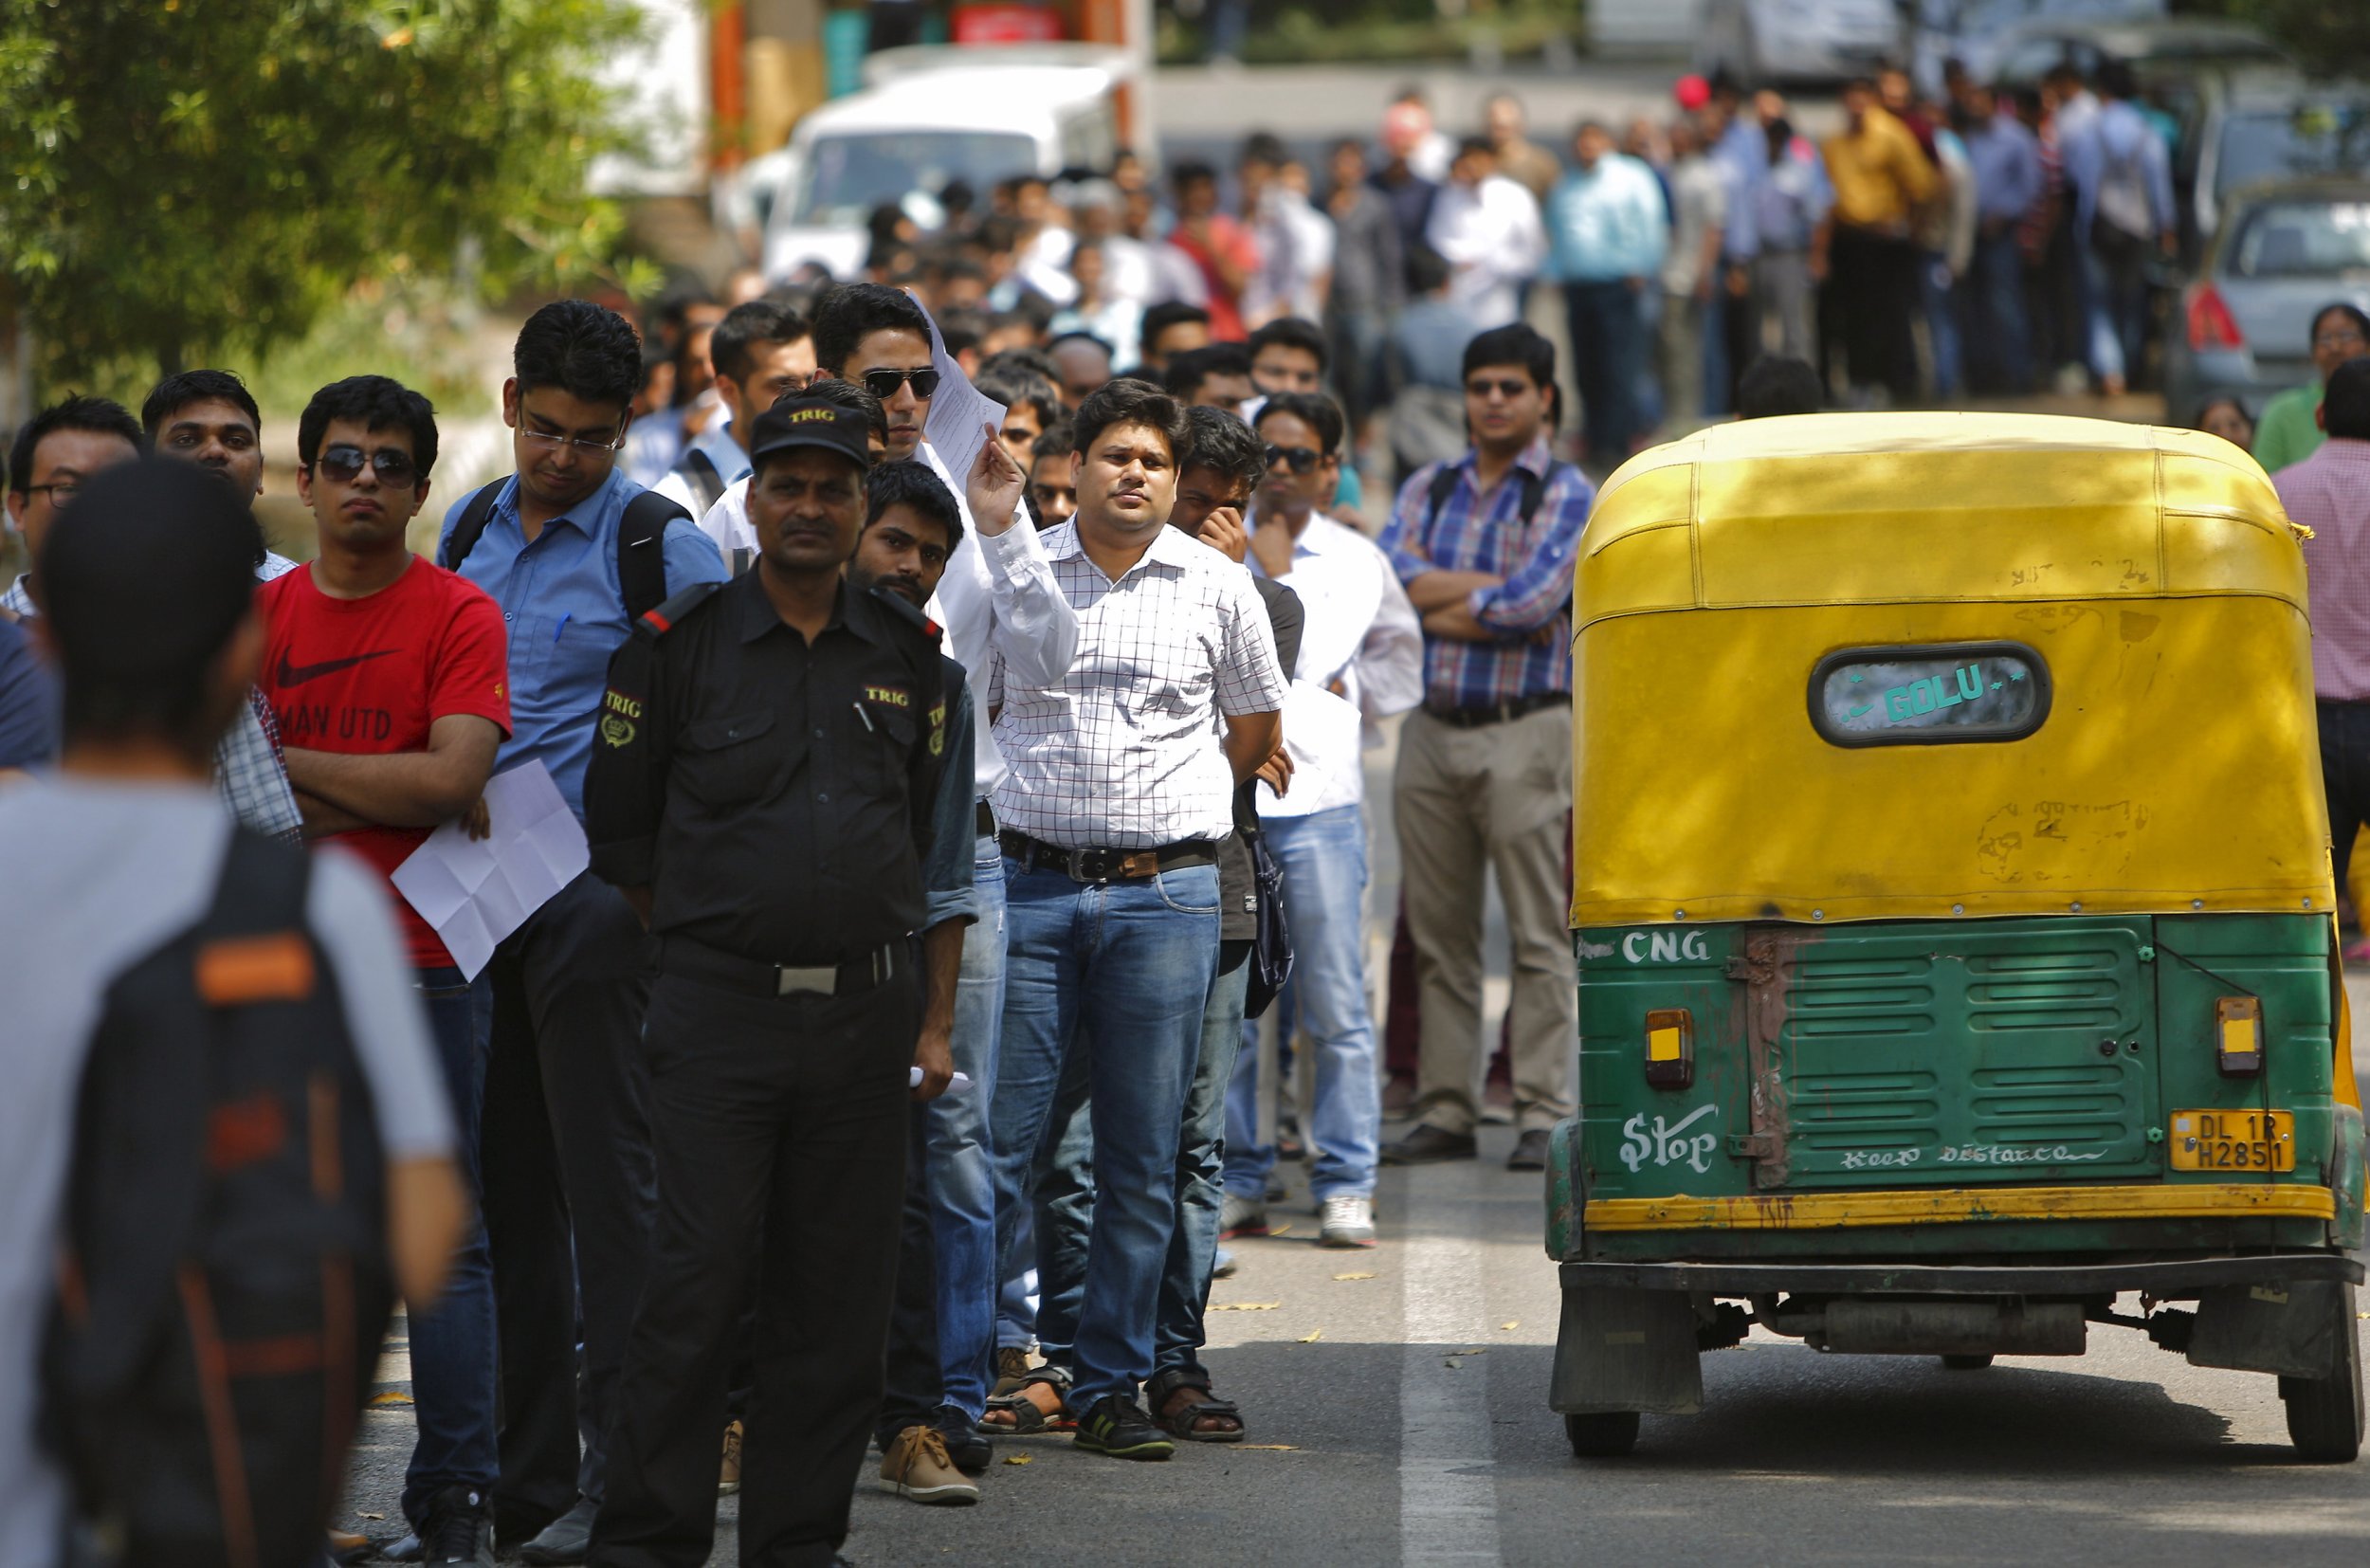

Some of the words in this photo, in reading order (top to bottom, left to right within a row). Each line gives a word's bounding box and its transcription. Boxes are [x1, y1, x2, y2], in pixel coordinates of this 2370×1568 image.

[788, 408, 835, 424] TRIG
[606, 690, 642, 719] TRIG
[865, 687, 910, 707] TRIG
[1884, 664, 1985, 723] GOLU
[275, 704, 330, 738] MAN
[338, 706, 392, 741] UTD
[1622, 930, 1712, 964] CNG
[1619, 1103, 1720, 1174] Stop
[2199, 1114, 2233, 1140] DL
[2247, 1113, 2276, 1140] 1R
[2198, 1141, 2283, 1168] H2851
